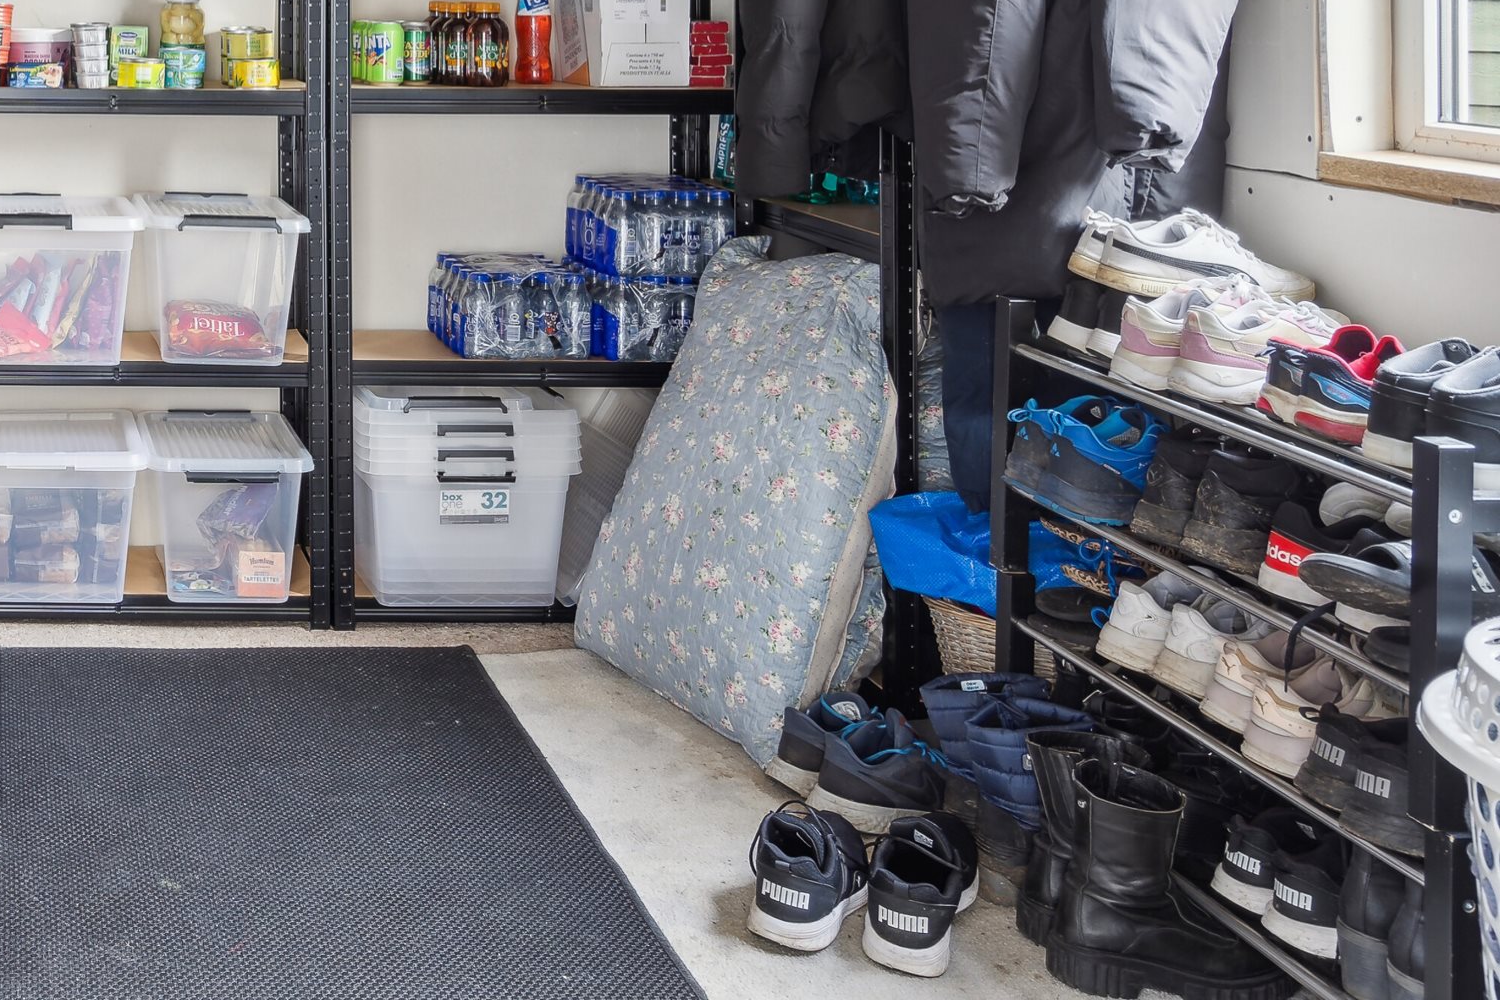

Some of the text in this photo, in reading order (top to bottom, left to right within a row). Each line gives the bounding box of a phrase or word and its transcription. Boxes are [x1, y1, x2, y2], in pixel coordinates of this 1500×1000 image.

[404, 49, 430, 58] ONDI
[717, 122, 730, 169] IMPRESS
[190, 316, 245, 337] Taffel
[441, 491, 508, 510] box 32
[441, 500, 463, 509] one
[1225, 841, 1261, 876] UMA
[761, 878, 810, 910] PUMA
[877, 904, 929, 934] PUMA
